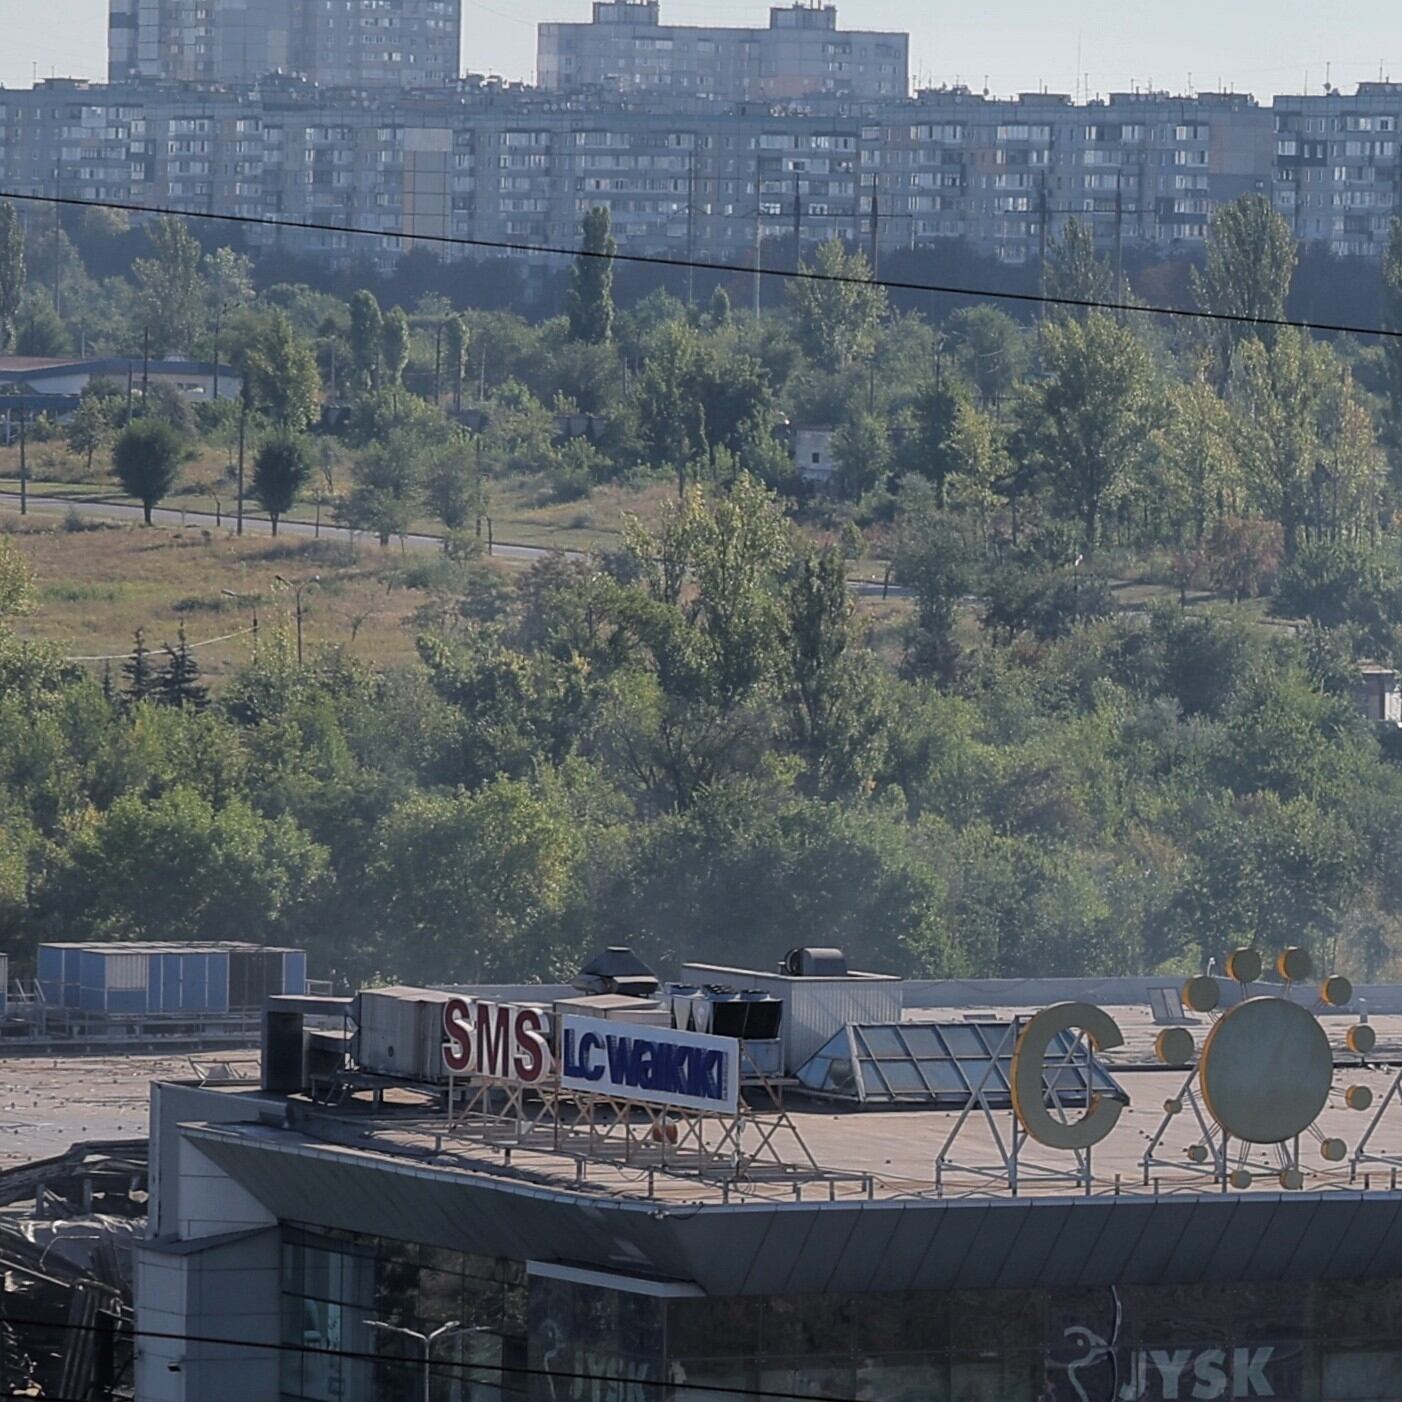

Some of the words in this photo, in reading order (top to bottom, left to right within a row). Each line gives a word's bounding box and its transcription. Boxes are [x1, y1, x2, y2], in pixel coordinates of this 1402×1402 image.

[442, 998, 549, 1083] SMS
[563, 1028, 605, 1081] LC
[1119, 1346, 1276, 1401] JYSK
